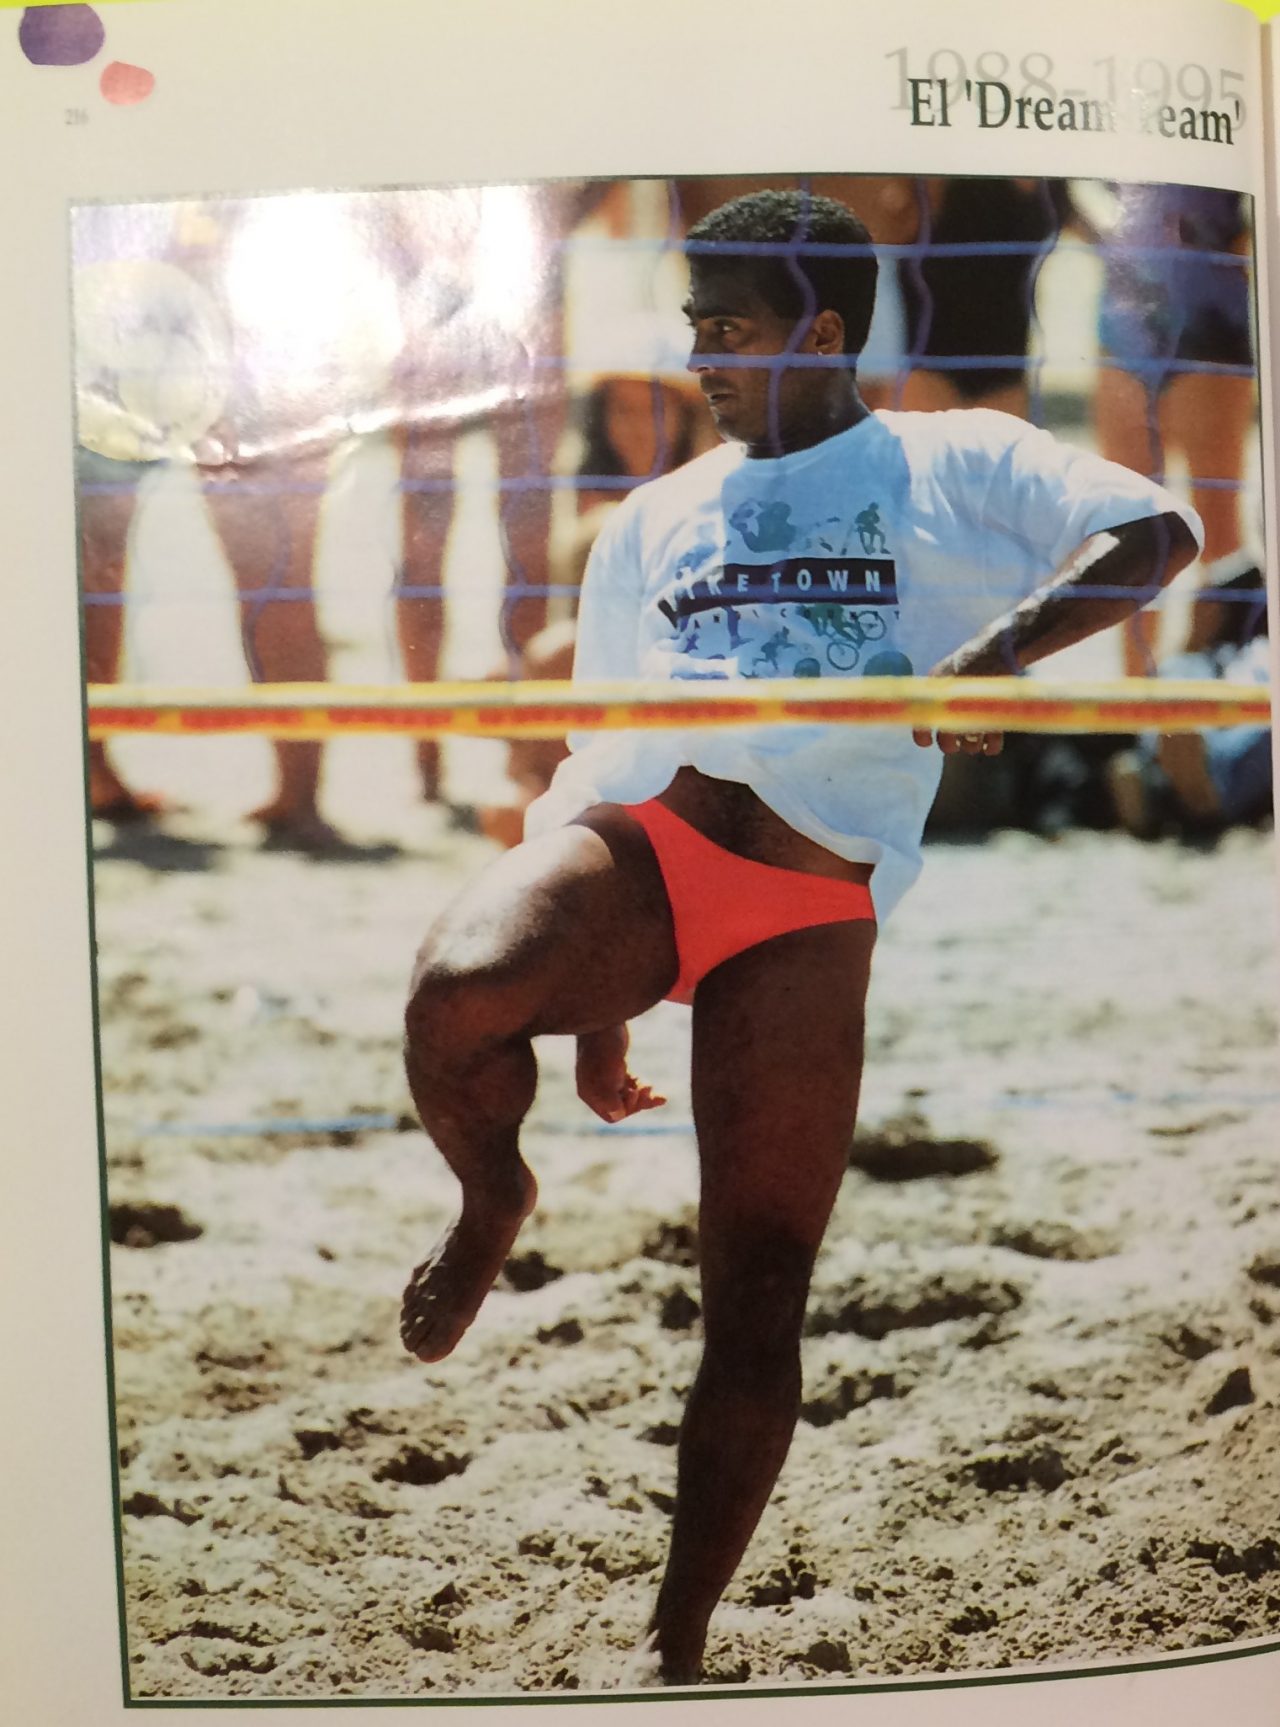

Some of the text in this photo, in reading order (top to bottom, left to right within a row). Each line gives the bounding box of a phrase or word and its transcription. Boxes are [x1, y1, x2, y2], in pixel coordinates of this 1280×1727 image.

[907, 77, 951, 126] El
[1130, 97, 1238, 145] eam'
[666, 569, 884, 612] KETOWN
